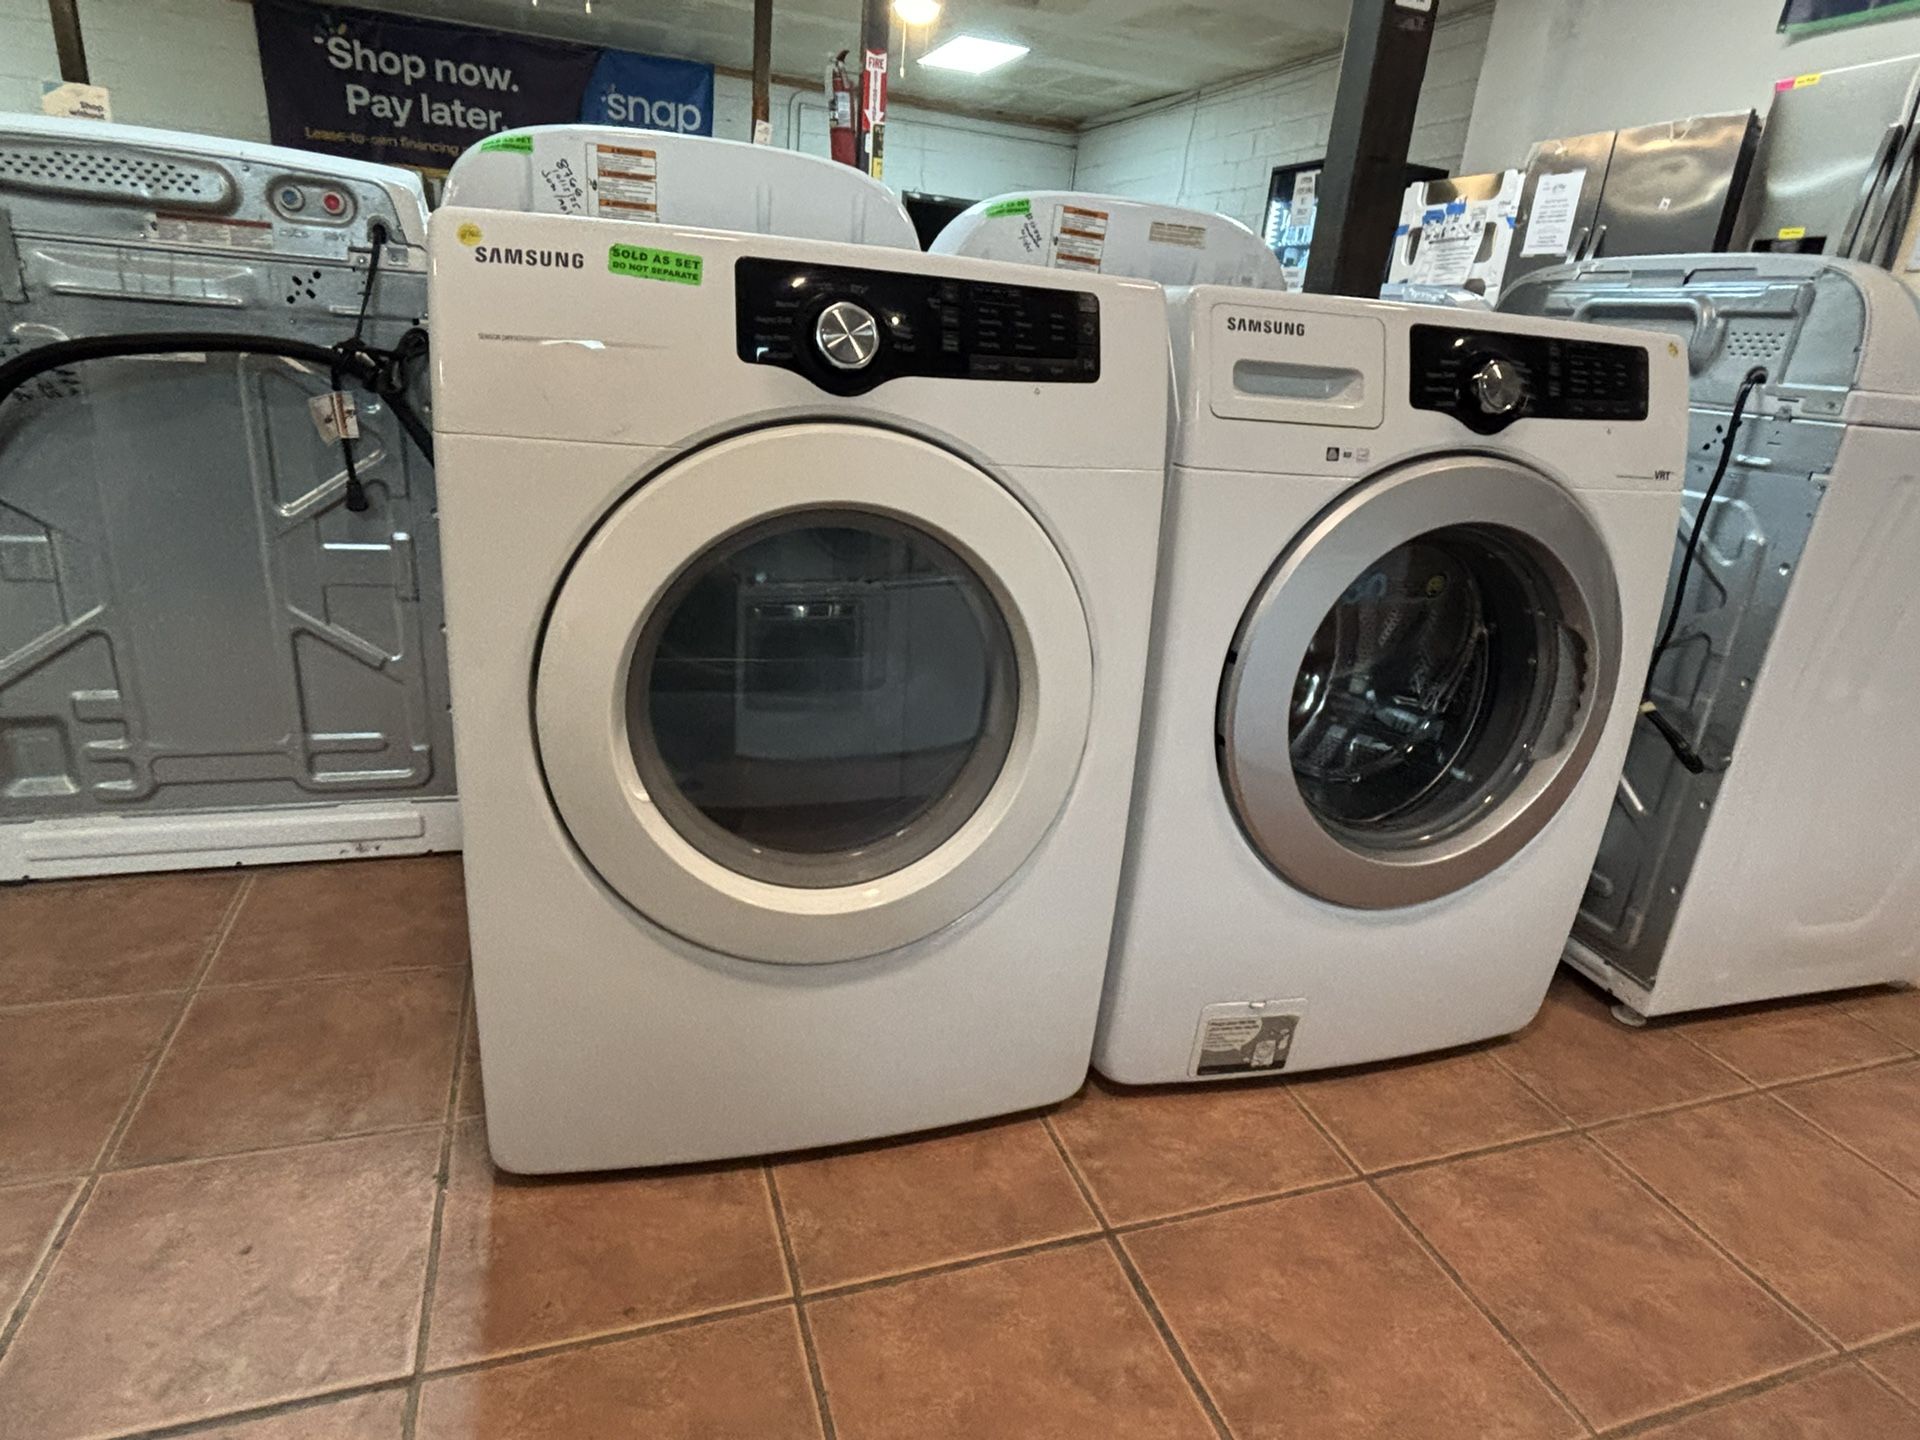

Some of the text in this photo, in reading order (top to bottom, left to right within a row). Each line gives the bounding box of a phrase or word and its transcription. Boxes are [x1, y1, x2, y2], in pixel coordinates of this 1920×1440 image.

[327, 36, 519, 92] Shop now.
[868, 57, 884, 70] FIRE
[346, 84, 413, 127] Pay
[607, 93, 701, 133] snap
[475, 246, 585, 269] SAMSUNG
[612, 247, 700, 270] SOLD AS SET
[612, 261, 699, 281] DO NOT SEPARATE
[1227, 317, 1306, 337] SAMSUNG
